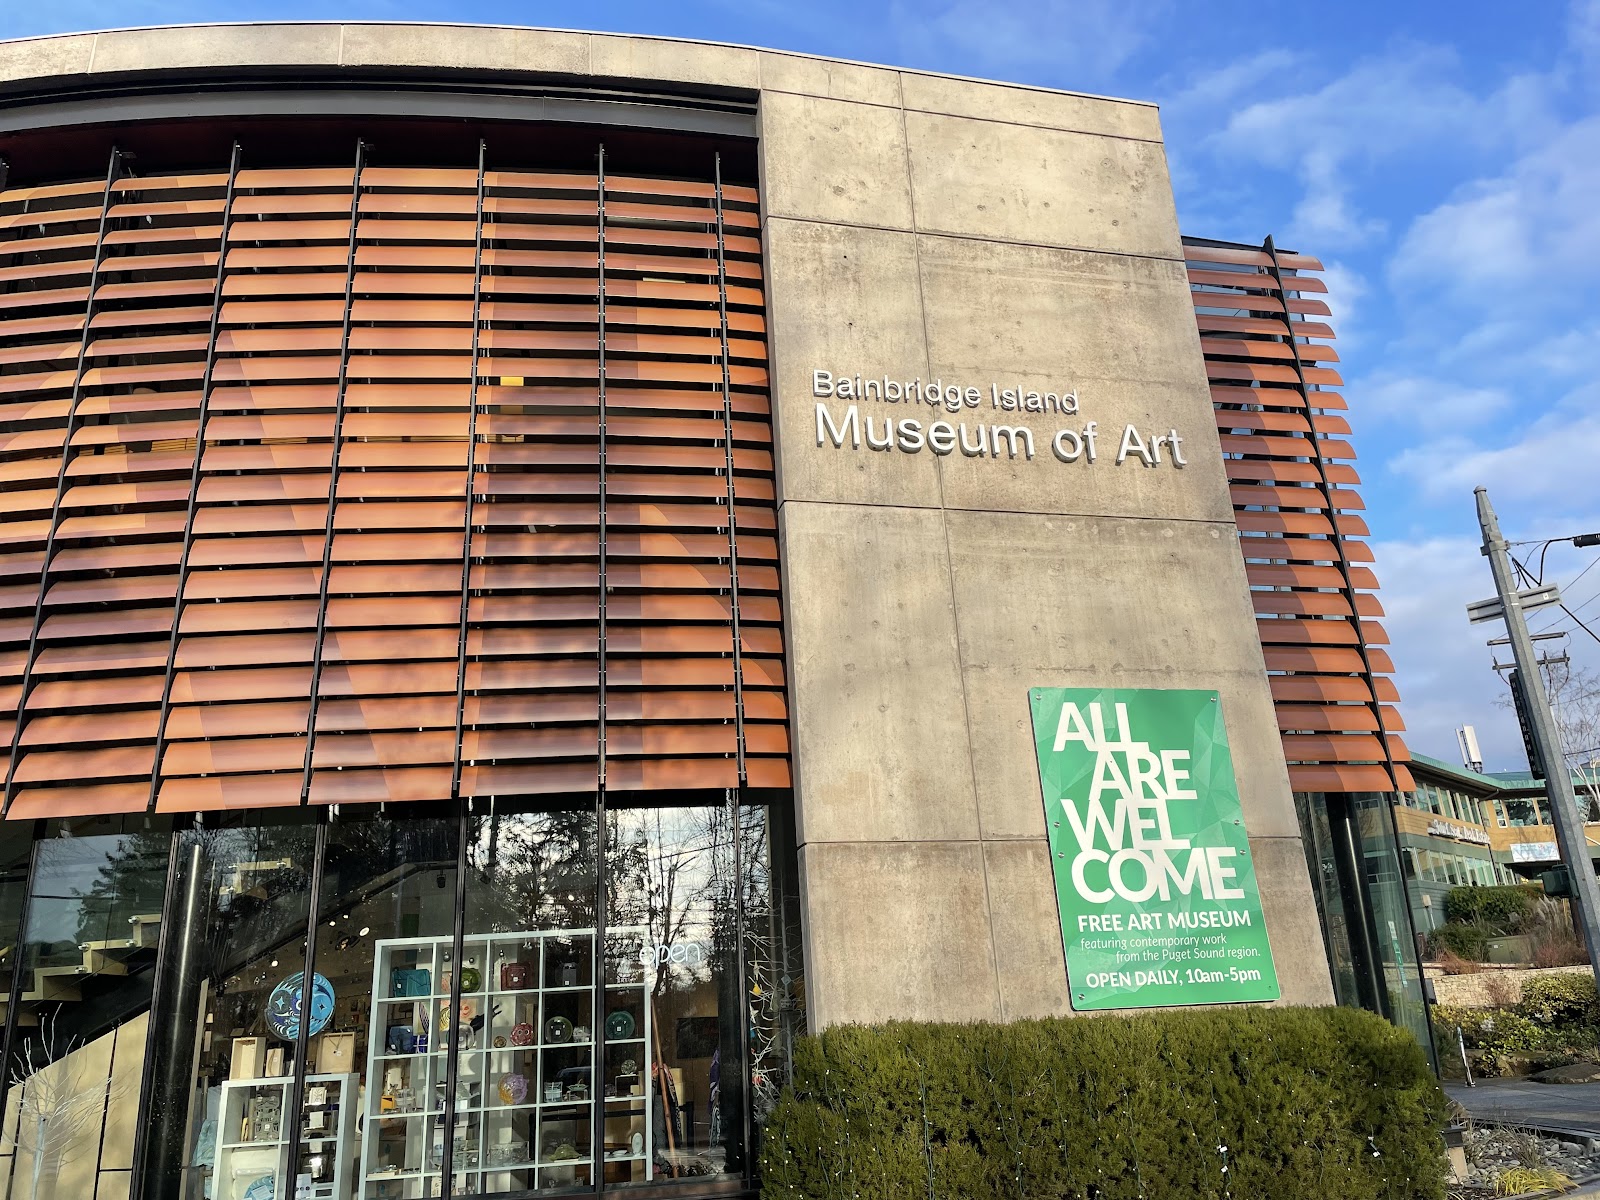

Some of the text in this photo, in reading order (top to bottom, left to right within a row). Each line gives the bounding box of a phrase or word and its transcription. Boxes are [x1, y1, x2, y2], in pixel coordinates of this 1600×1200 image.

[812, 369, 1080, 414] Bainbridge Island
[814, 402, 1187, 467] Museum of Art
[1052, 702, 1149, 752] ALL
[1088, 749, 1198, 801] ARE
[1060, 798, 1191, 851] WEL
[1071, 846, 1246, 903] COME
[1077, 910, 1252, 933] FREE ART MUSEUM
[1080, 932, 1228, 951] featuring contemporary work
[639, 943, 701, 970] open
[1116, 946, 1261, 964] from the Puget Sound region.
[1085, 967, 1261, 989] OPEN DAILY, 10am-5pm
